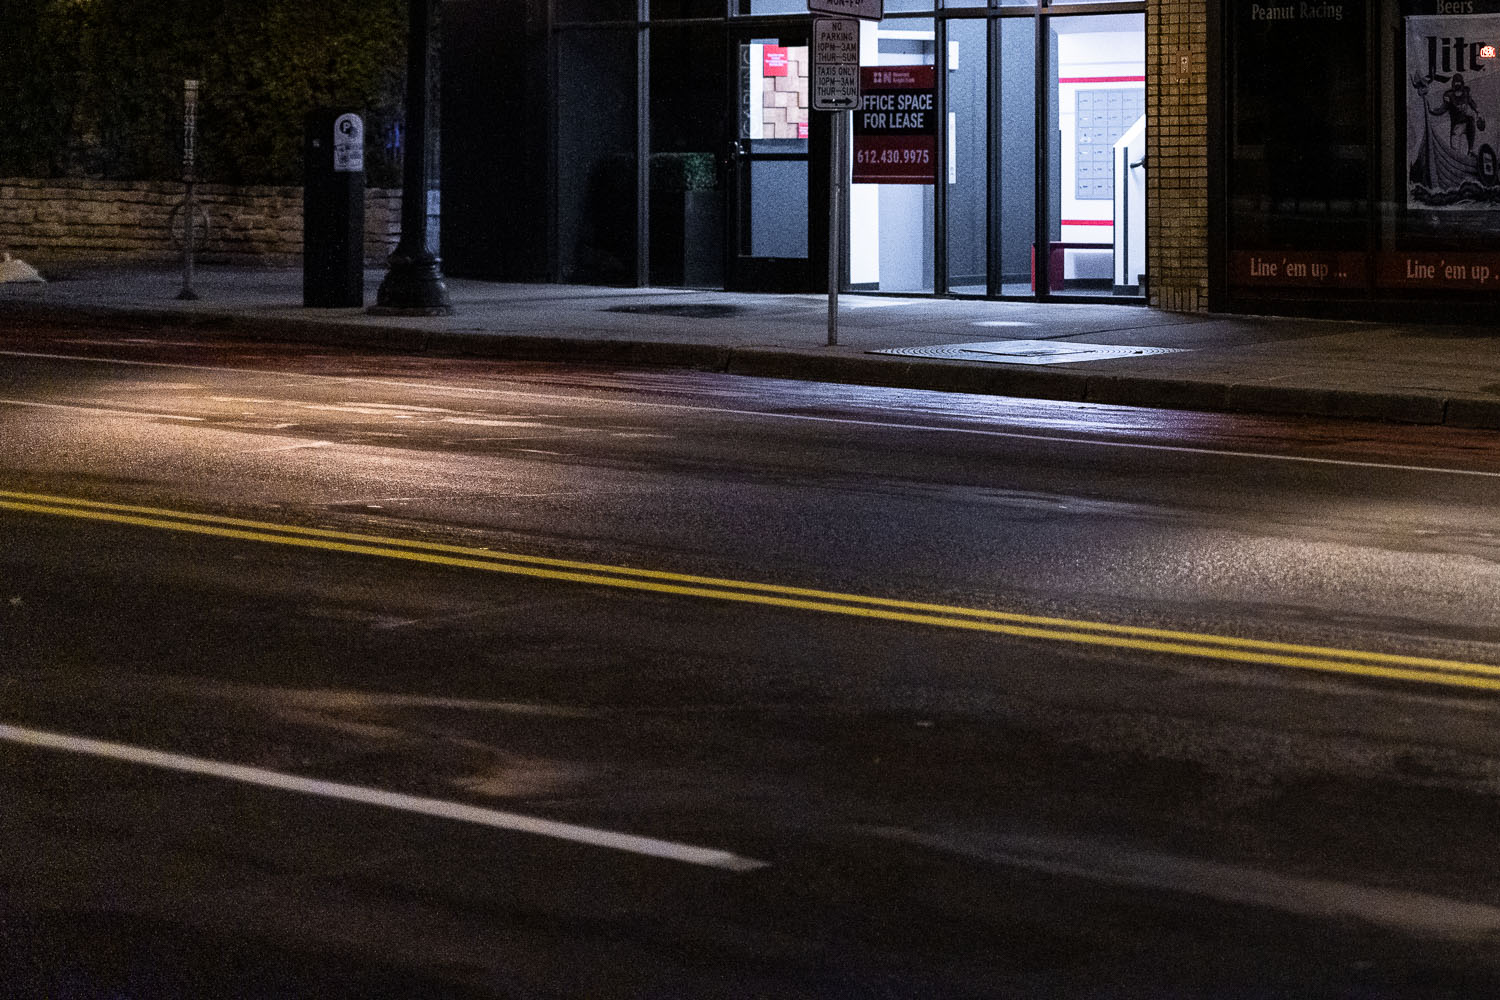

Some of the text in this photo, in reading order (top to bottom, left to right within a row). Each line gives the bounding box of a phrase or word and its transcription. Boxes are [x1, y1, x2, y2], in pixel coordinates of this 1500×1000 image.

[1252, 1, 1343, 21] Peanut Racing
[831, 22, 842, 31] NO
[821, 32, 853, 41] PARKING
[1425, 36, 1487, 85] Lite
[817, 66, 856, 76] TAXIS ONLY
[897, 94, 933, 110] SPACE
[863, 112, 925, 128] FOR LEASE
[857, 149, 930, 164] 612.430.9975
[1250, 257, 1277, 278] Line
[1311, 262, 1329, 281] up
[1406, 259, 1434, 279] Line
[1471, 264, 1490, 284] up
